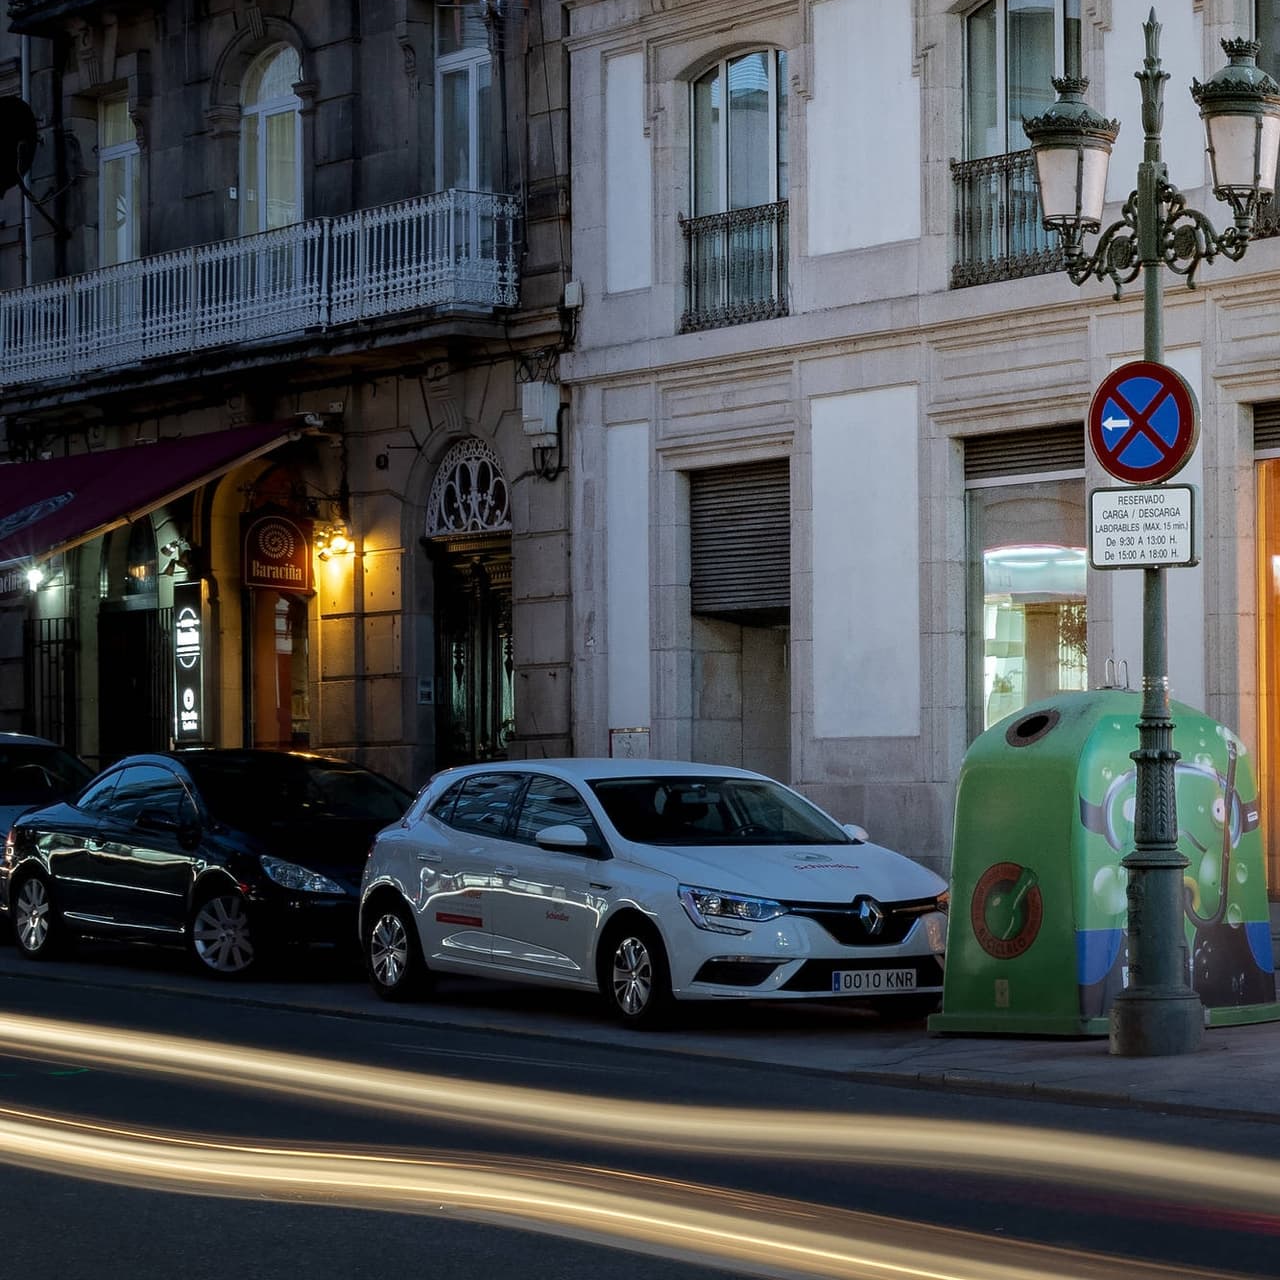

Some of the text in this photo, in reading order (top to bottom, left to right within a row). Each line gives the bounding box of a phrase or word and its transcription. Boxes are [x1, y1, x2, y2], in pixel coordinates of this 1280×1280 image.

[1117, 494, 1165, 505] RESERVADO
[1102, 509, 1129, 520] CARGA
[1138, 507, 1181, 518] DESCARGA
[1095, 523, 1140, 533] LABORABLES
[1163, 522, 1171, 530] 15
[1106, 537, 1117, 547] De
[1119, 536, 1135, 546] 9:30
[1138, 536, 1144, 545] A
[1147, 535, 1167, 545] 13:00
[1104, 550, 1115, 561] De
[1118, 550, 1138, 560] 15:00
[1140, 550, 1146, 559] A
[1149, 548, 1169, 559] 18:00
[252, 560, 302, 580] Baraciña
[843, 971, 914, 989] 0010 KNR
